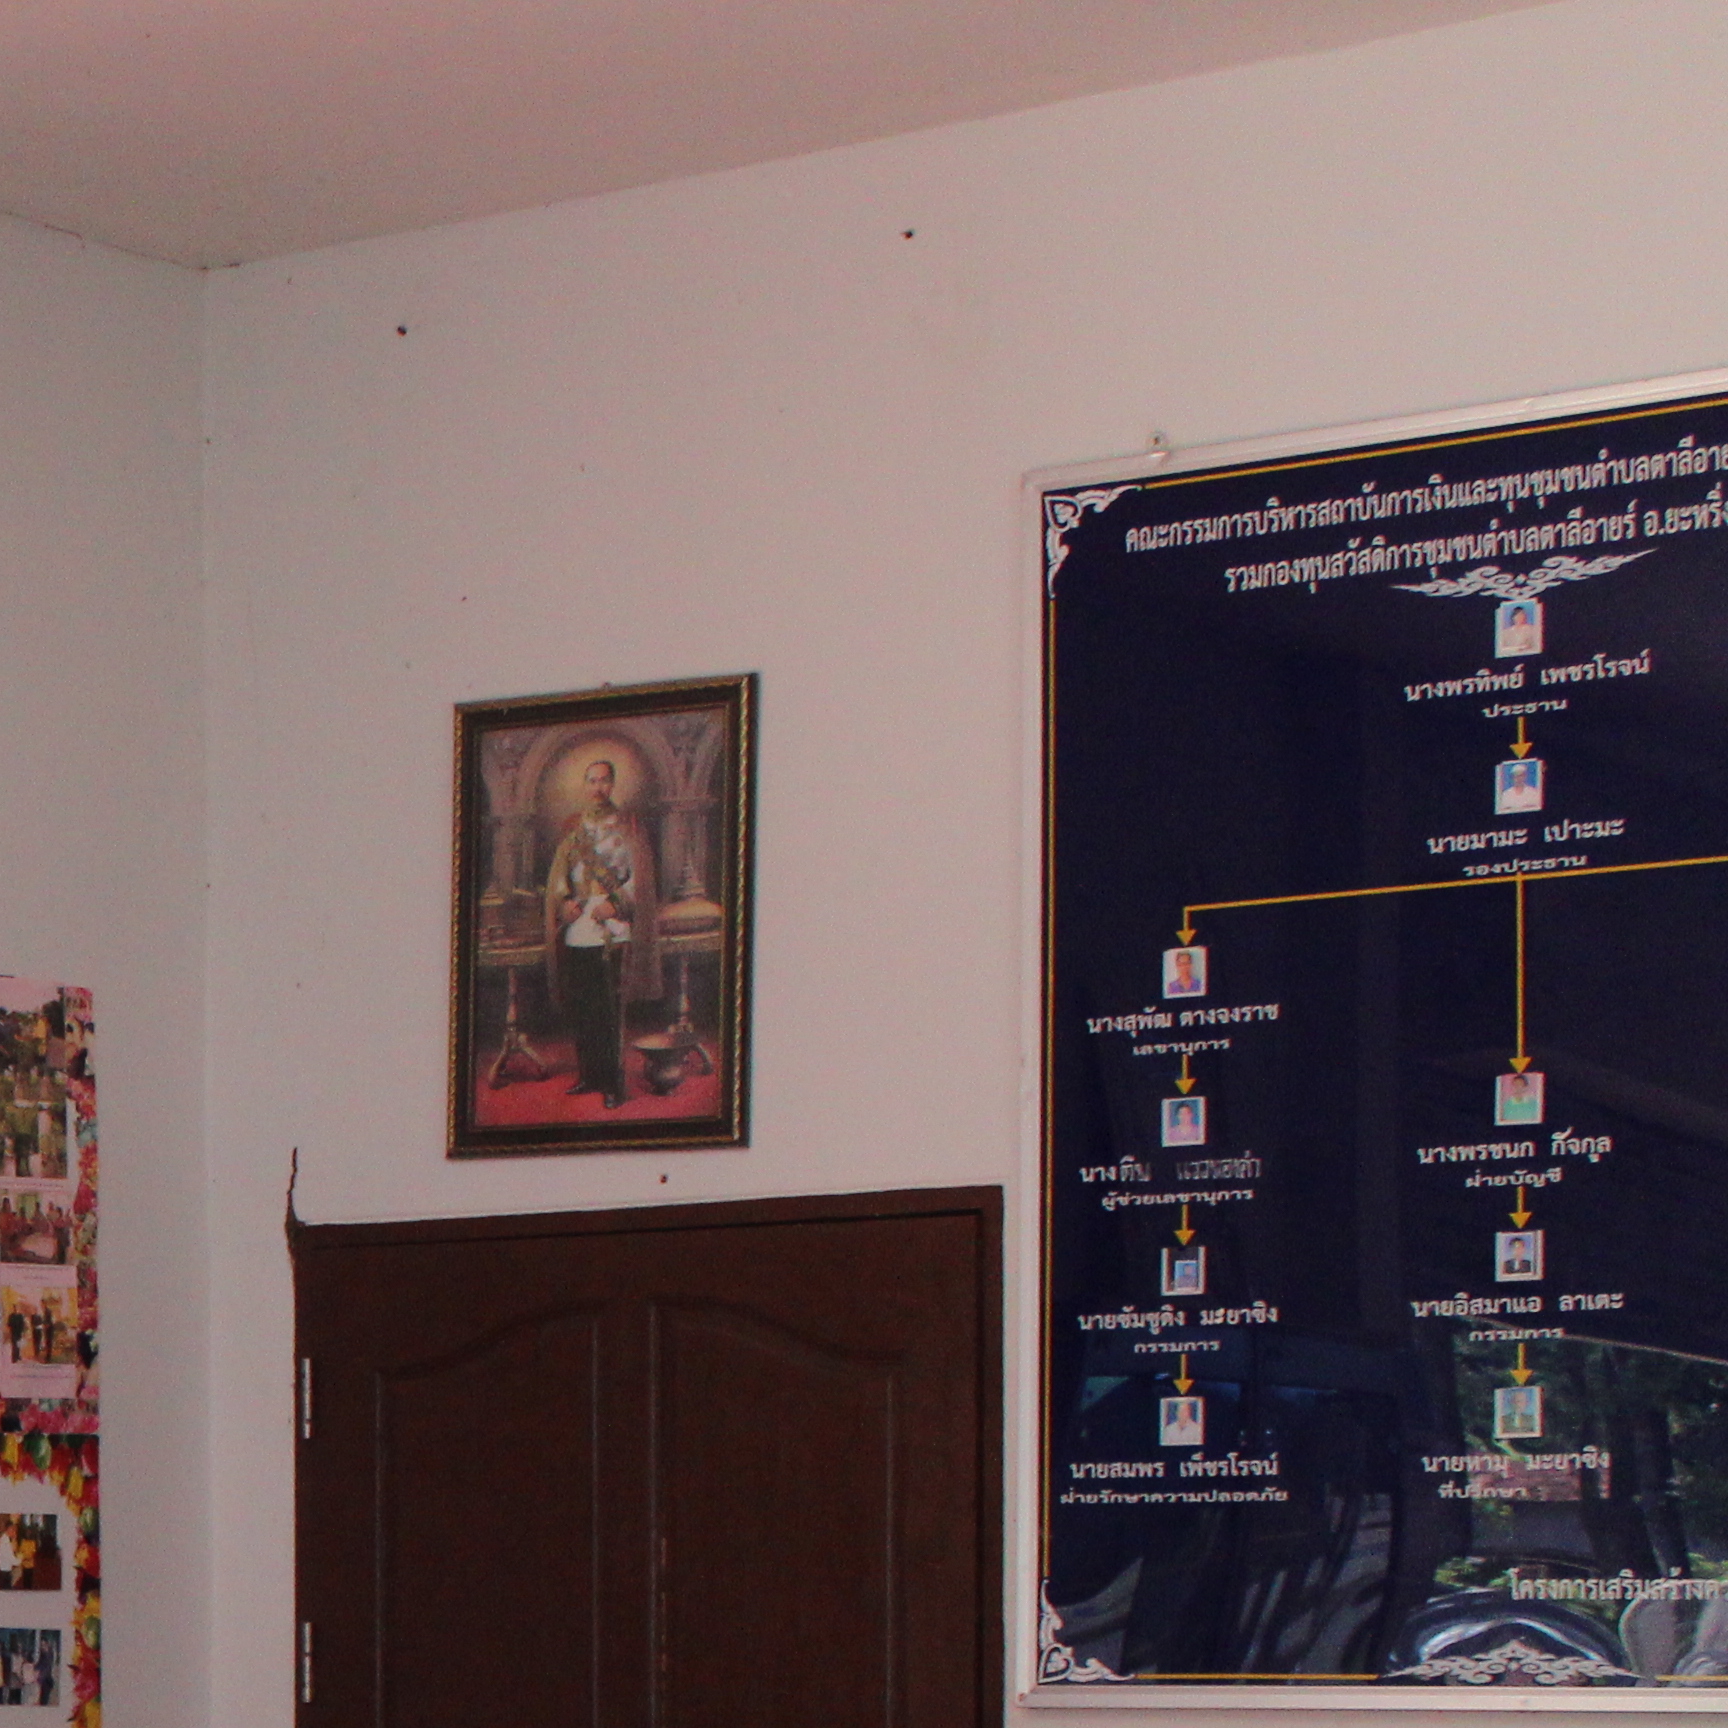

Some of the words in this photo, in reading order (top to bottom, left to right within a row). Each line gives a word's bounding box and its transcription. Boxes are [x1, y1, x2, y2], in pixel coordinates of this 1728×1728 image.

[1481, 698, 1569, 719] ประธาน
[1468, 1327, 1567, 1342] กรรมการ
[1134, 1339, 1222, 1354] กรรมการ
